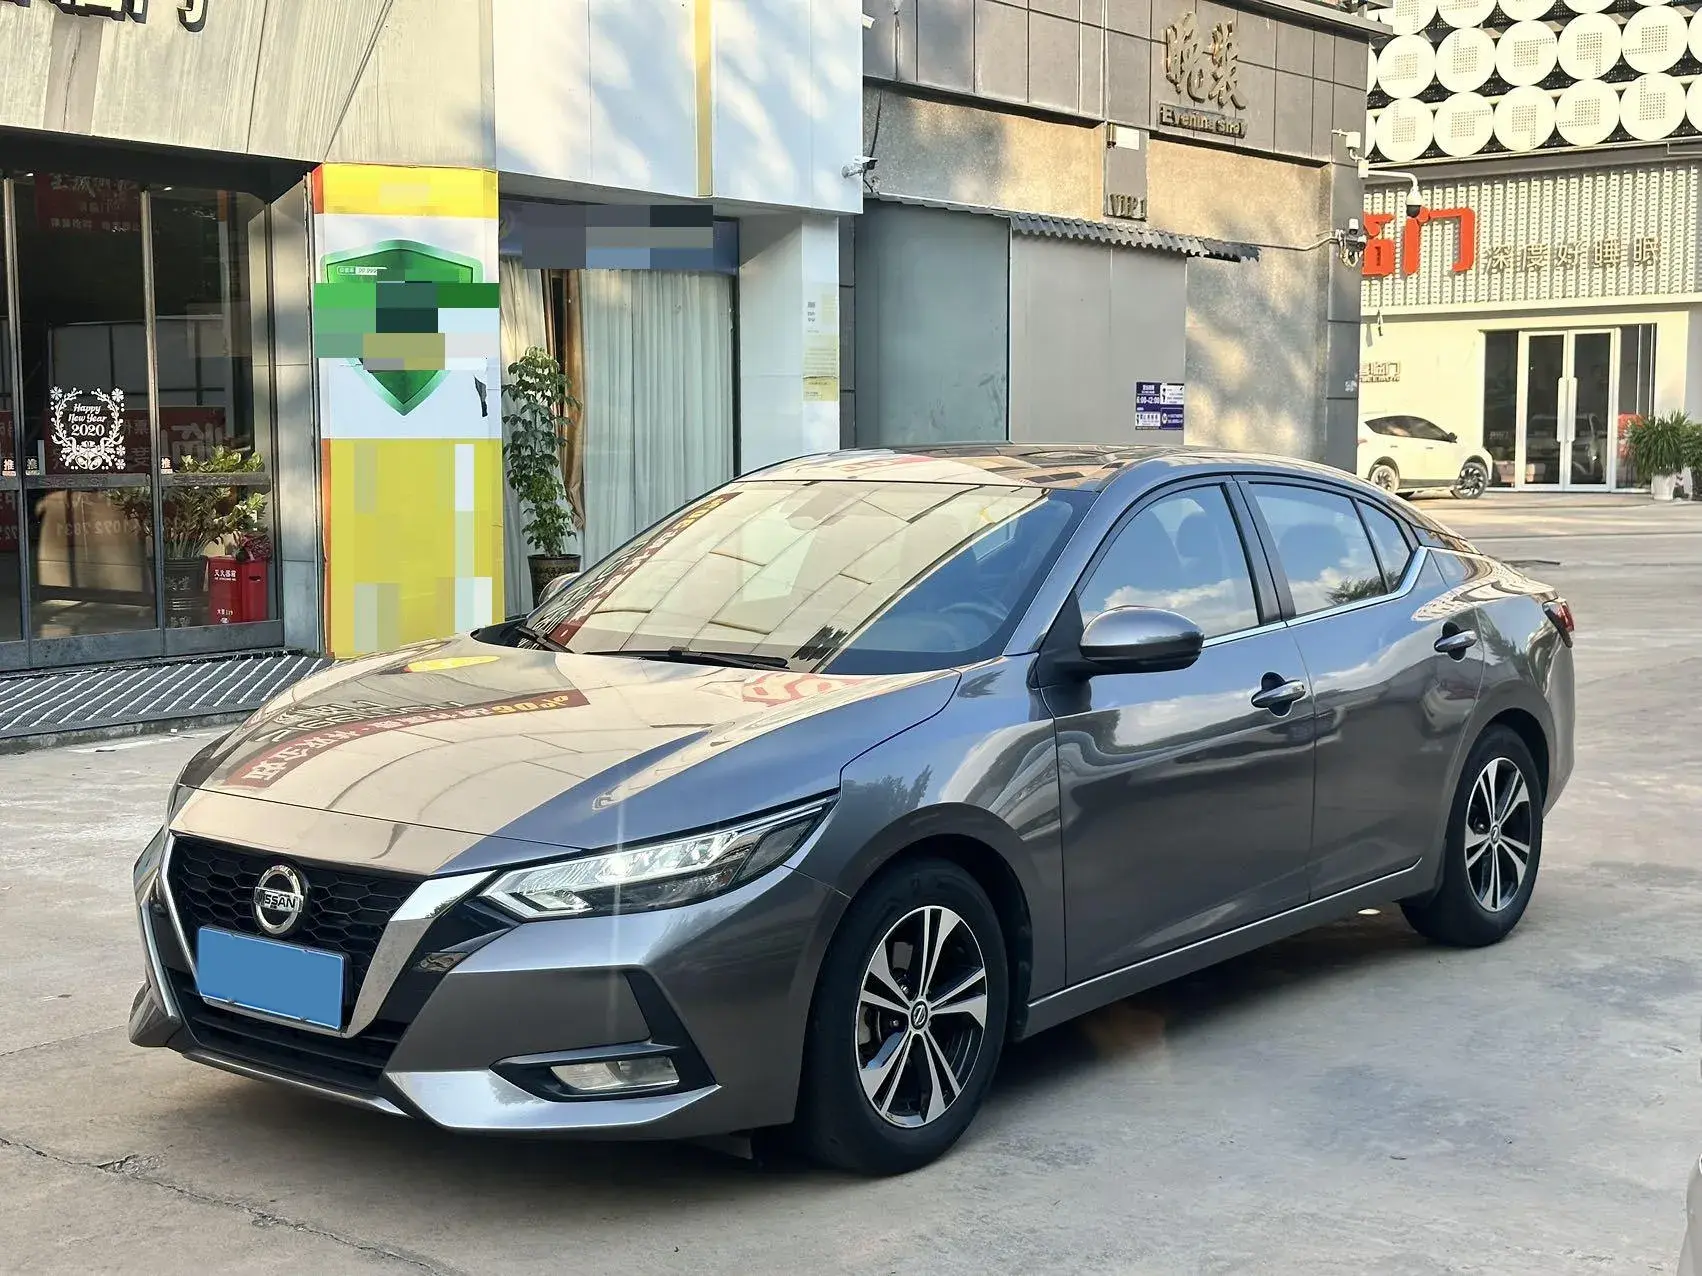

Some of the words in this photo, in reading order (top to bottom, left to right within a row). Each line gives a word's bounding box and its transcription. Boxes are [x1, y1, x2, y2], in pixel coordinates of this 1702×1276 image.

[1484, 236, 1660, 273] 深度好睡眠
[73, 403, 101, 415] Happy
[68, 413, 86, 423] New
[86, 413, 107, 423] Year
[71, 423, 105, 437] 2020
